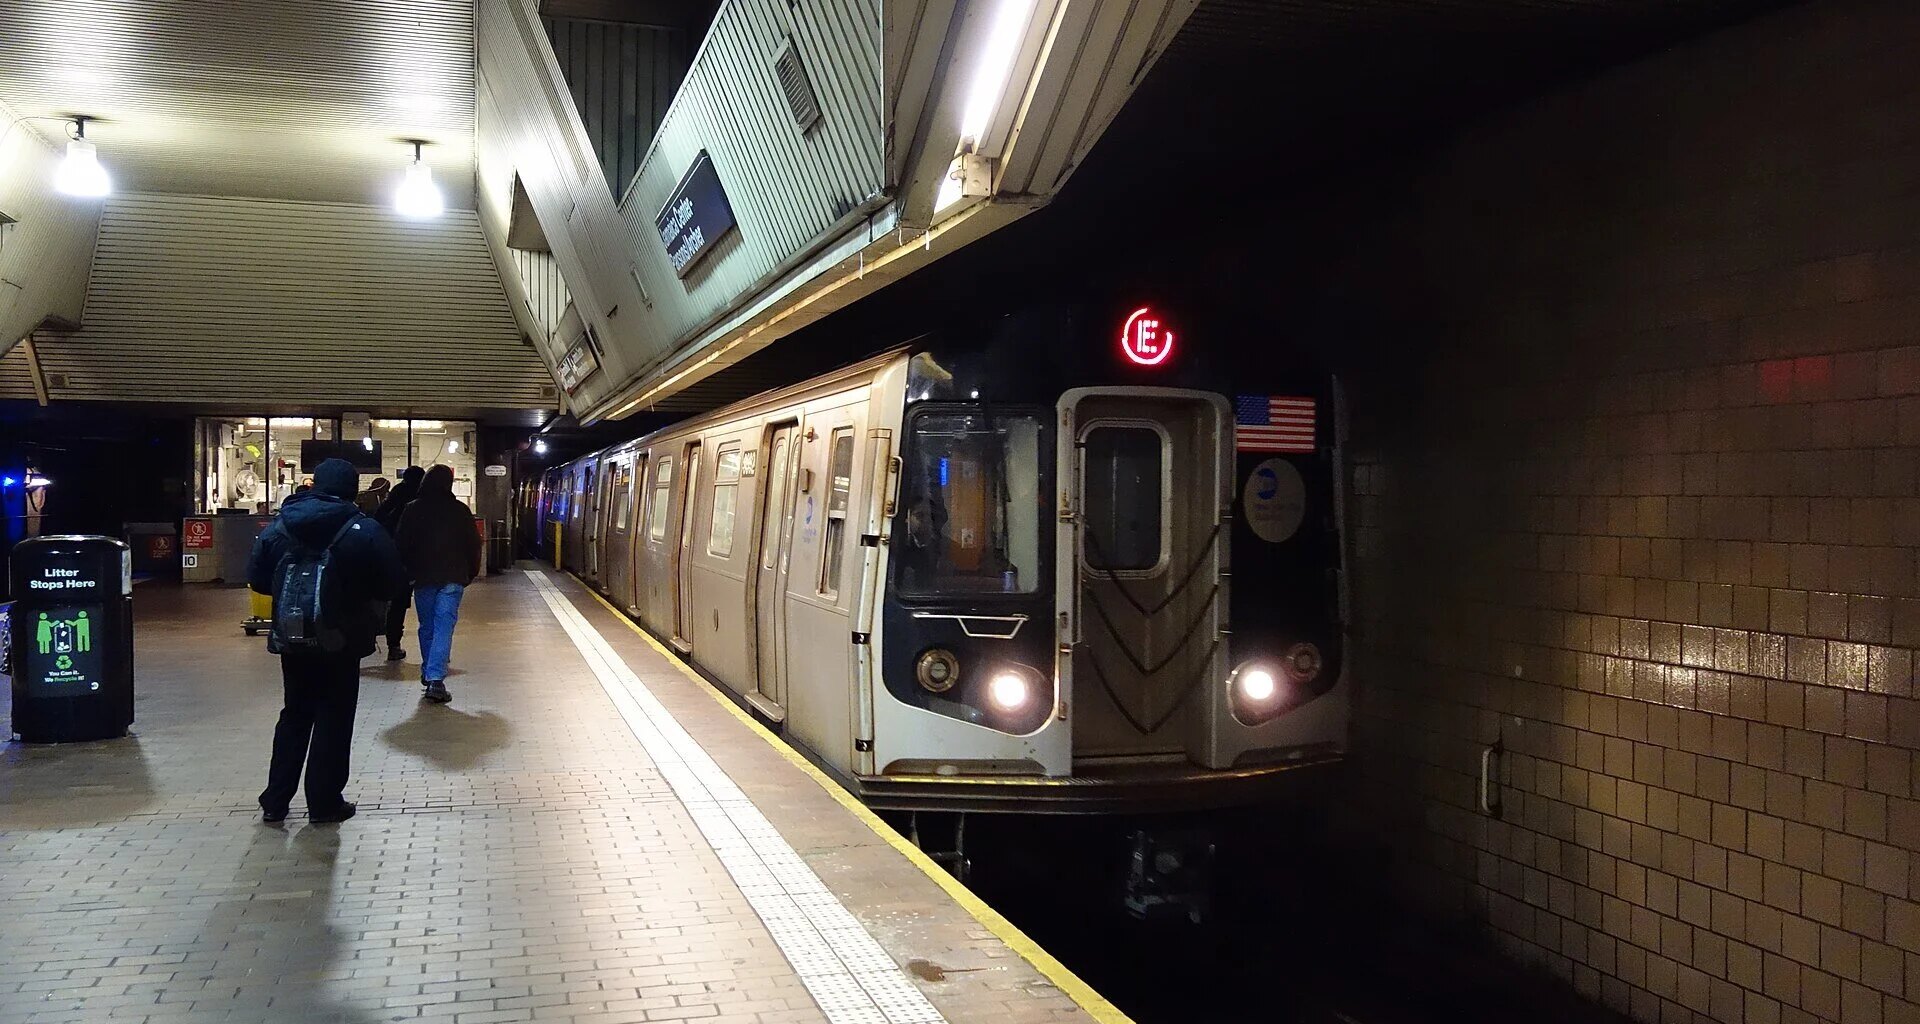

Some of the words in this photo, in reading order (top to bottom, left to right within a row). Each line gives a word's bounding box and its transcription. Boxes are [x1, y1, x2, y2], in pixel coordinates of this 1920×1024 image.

[1136, 319, 1159, 353] E
[184, 556, 196, 566] 10
[44, 568, 80, 577] Litter
[30, 580, 64, 590] Stops
[65, 579, 96, 588] Here
